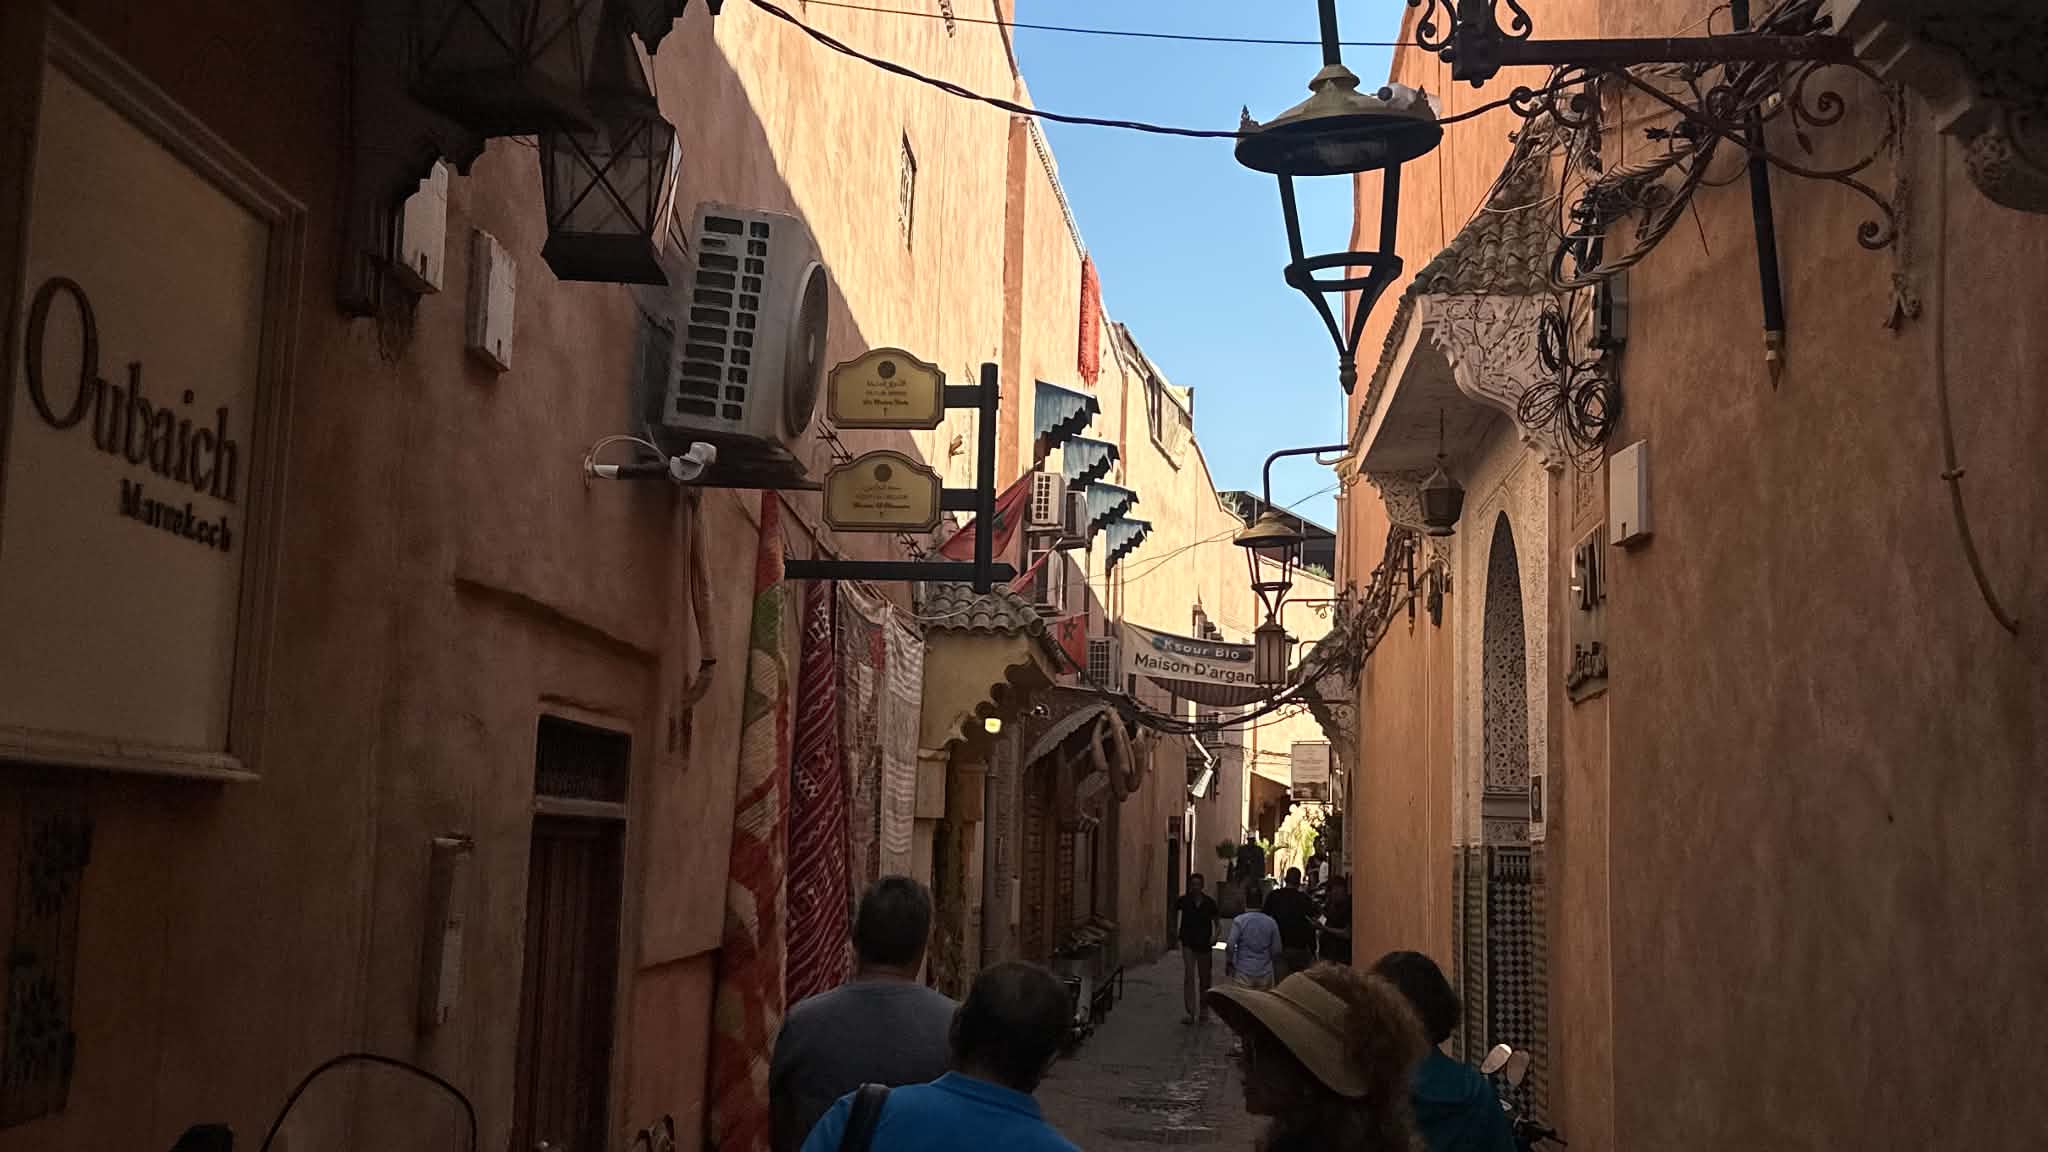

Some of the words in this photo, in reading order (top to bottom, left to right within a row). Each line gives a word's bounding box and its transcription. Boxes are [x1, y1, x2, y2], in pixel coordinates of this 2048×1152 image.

[26, 276, 238, 504] Oubaich
[1163, 639, 1208, 655] Ksour
[1215, 648, 1240, 660] Bio
[1134, 653, 1190, 673] Maison
[1194, 662, 1255, 683] D'argan
